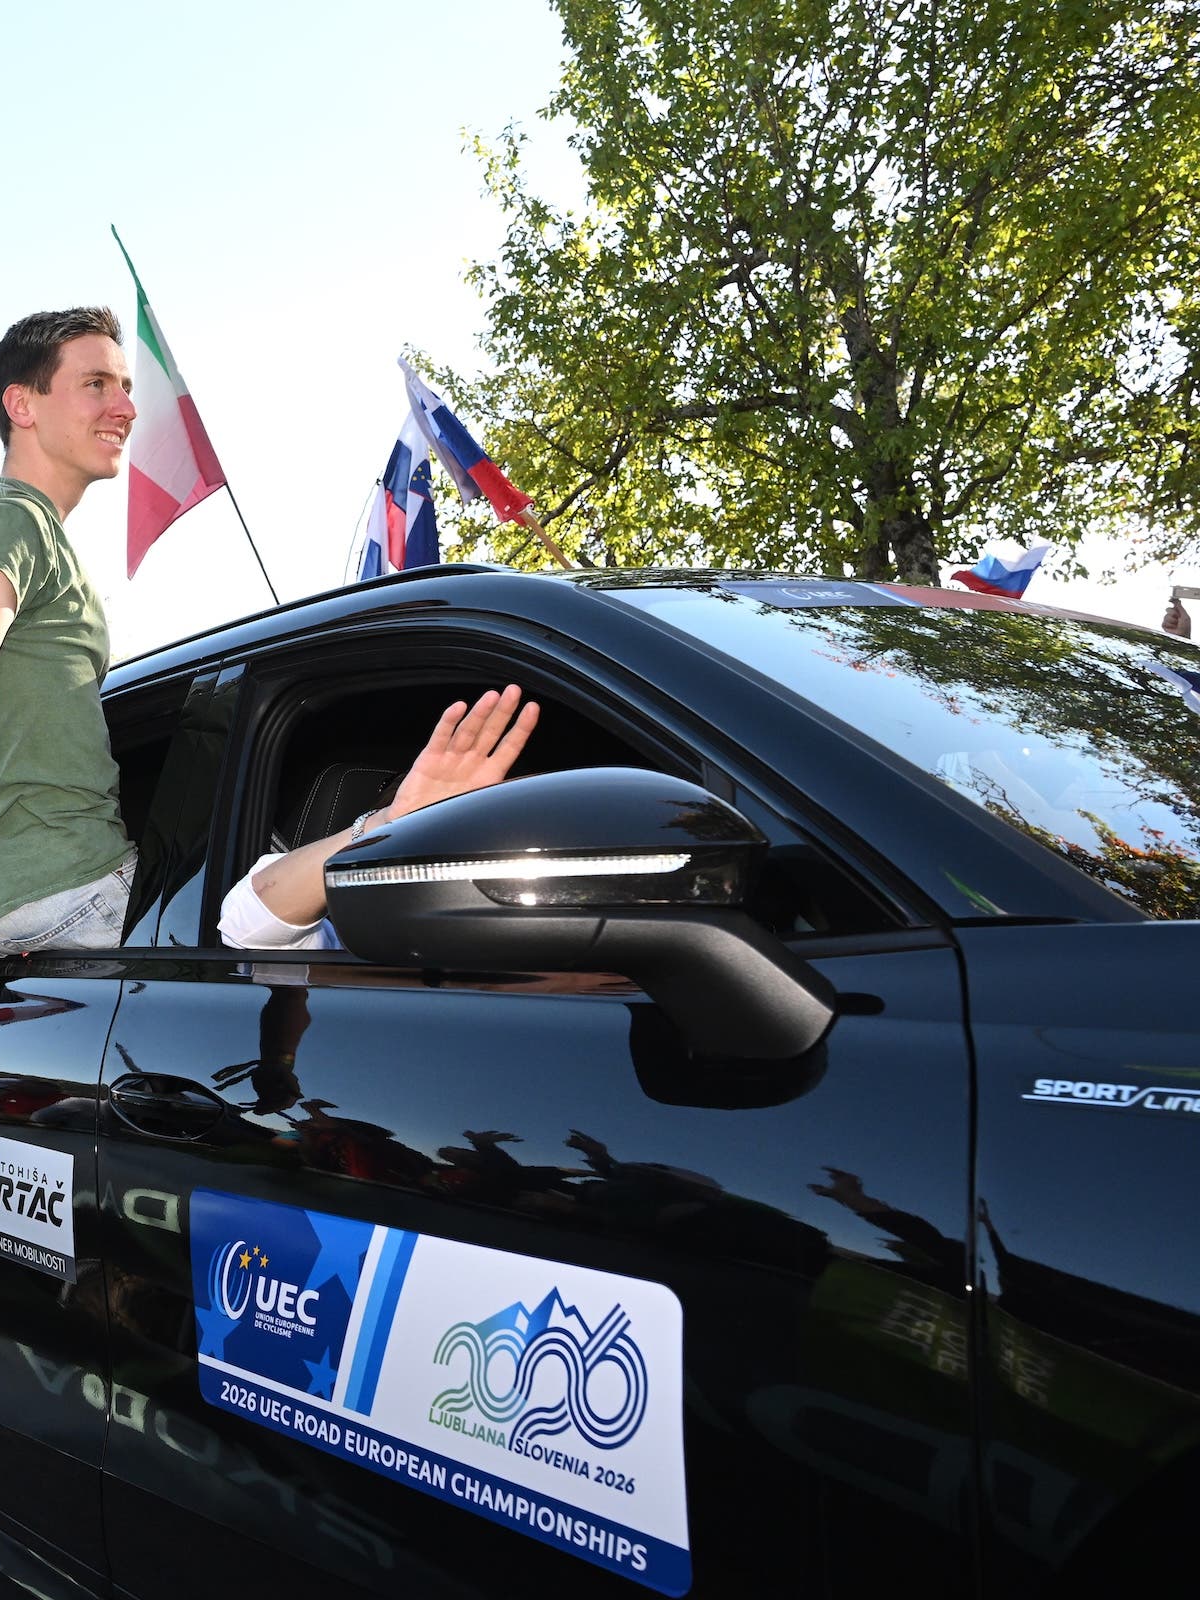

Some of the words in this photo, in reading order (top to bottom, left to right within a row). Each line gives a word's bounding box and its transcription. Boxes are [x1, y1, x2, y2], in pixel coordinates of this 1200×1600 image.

[1033, 1078, 1139, 1101] SPORT
[14, 1241, 66, 1273] MOBILNOSTI
[256, 1275, 320, 1326] UEC
[254, 1319, 263, 1329] DE
[263, 1323, 292, 1338] CYCLISME
[255, 1311, 275, 1324] UNION
[428, 1407, 507, 1449] LJUBLJANA
[513, 1437, 590, 1479] SLOVENIA
[593, 1466, 636, 1495] 2026
[220, 1381, 257, 1412] 2026
[259, 1396, 292, 1426] UEC
[293, 1409, 341, 1446] ROAD
[345, 1429, 447, 1490] EUROPEAN
[451, 1472, 648, 1571] CHAMPIONSHIPS
